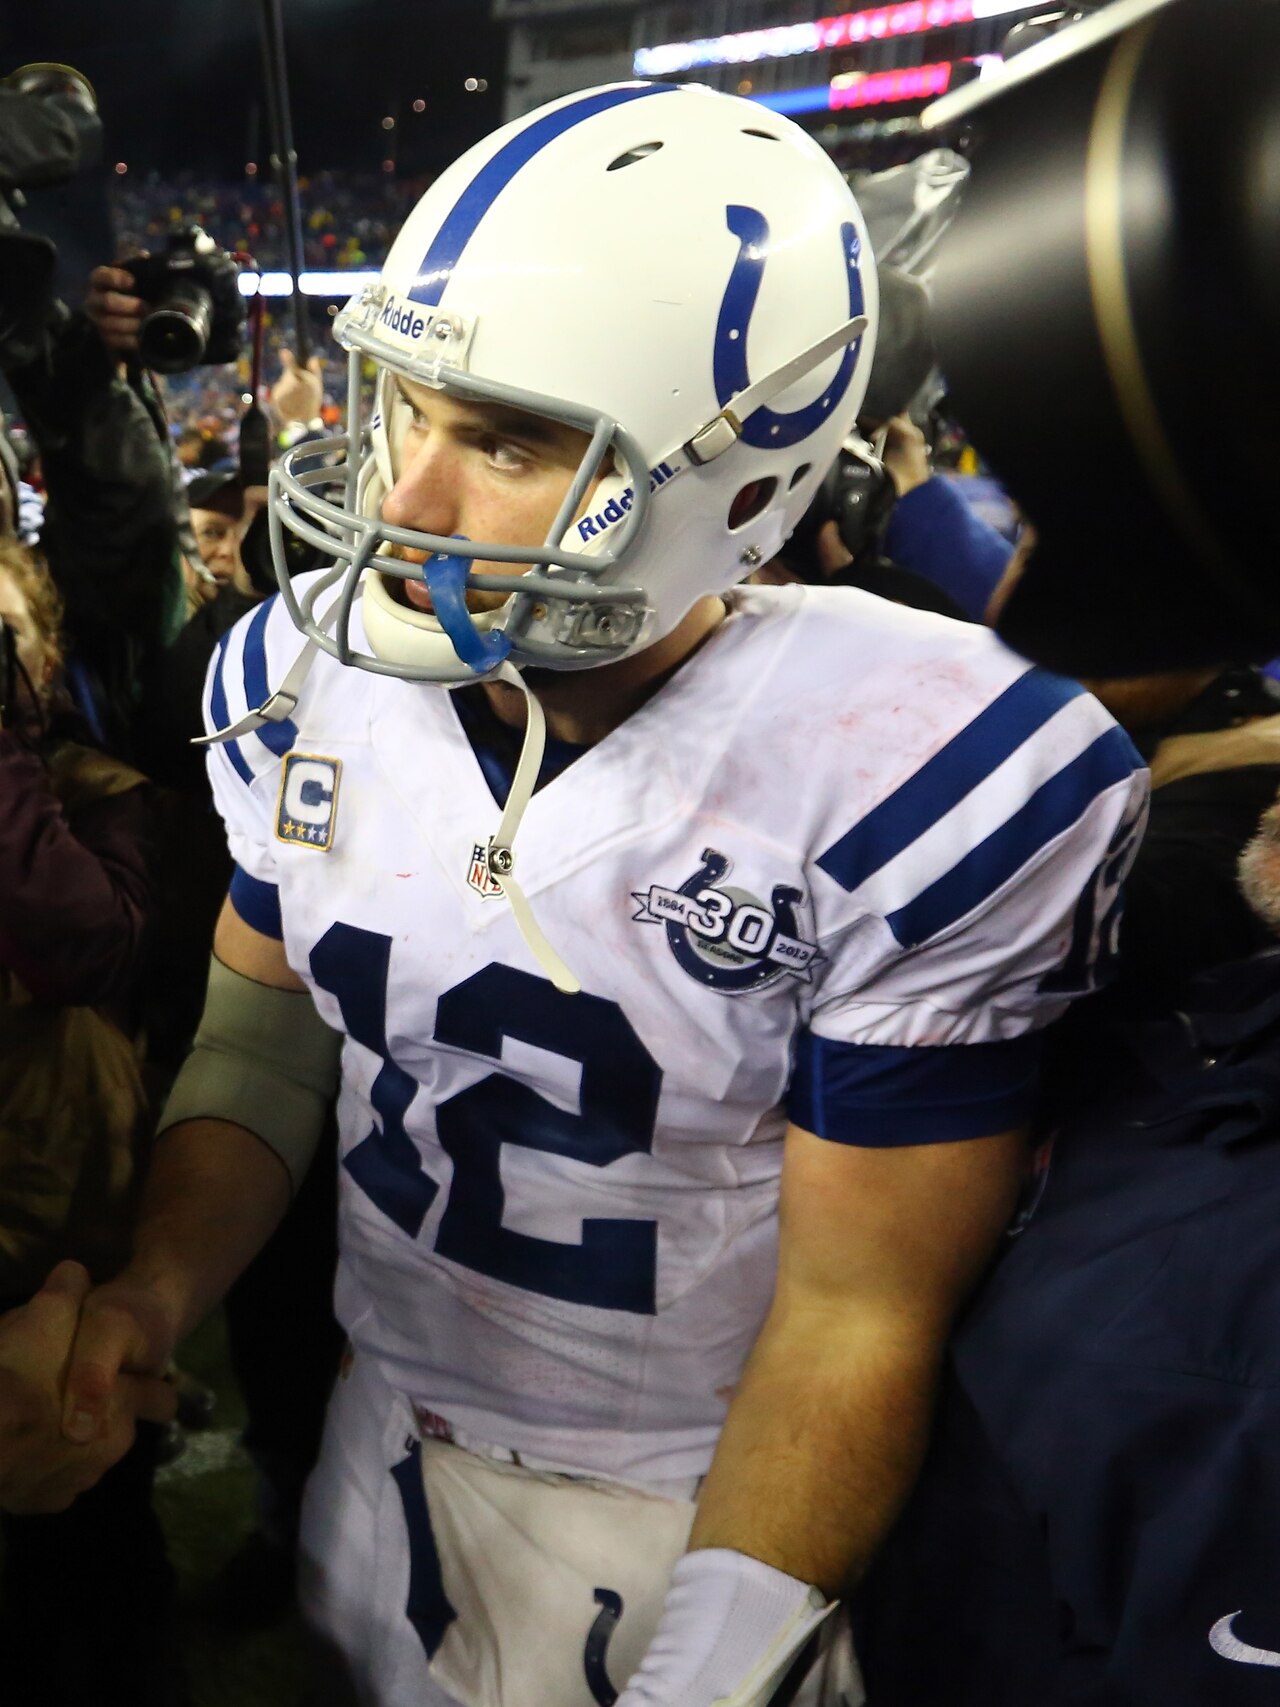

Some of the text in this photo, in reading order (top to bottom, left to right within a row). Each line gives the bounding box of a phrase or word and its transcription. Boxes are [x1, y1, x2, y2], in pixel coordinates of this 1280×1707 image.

[380, 295, 434, 339] Ridde
[577, 461, 675, 542] Riddll
[284, 761, 335, 825] C
[686, 888, 774, 954] 30
[309, 921, 663, 1315] 12
